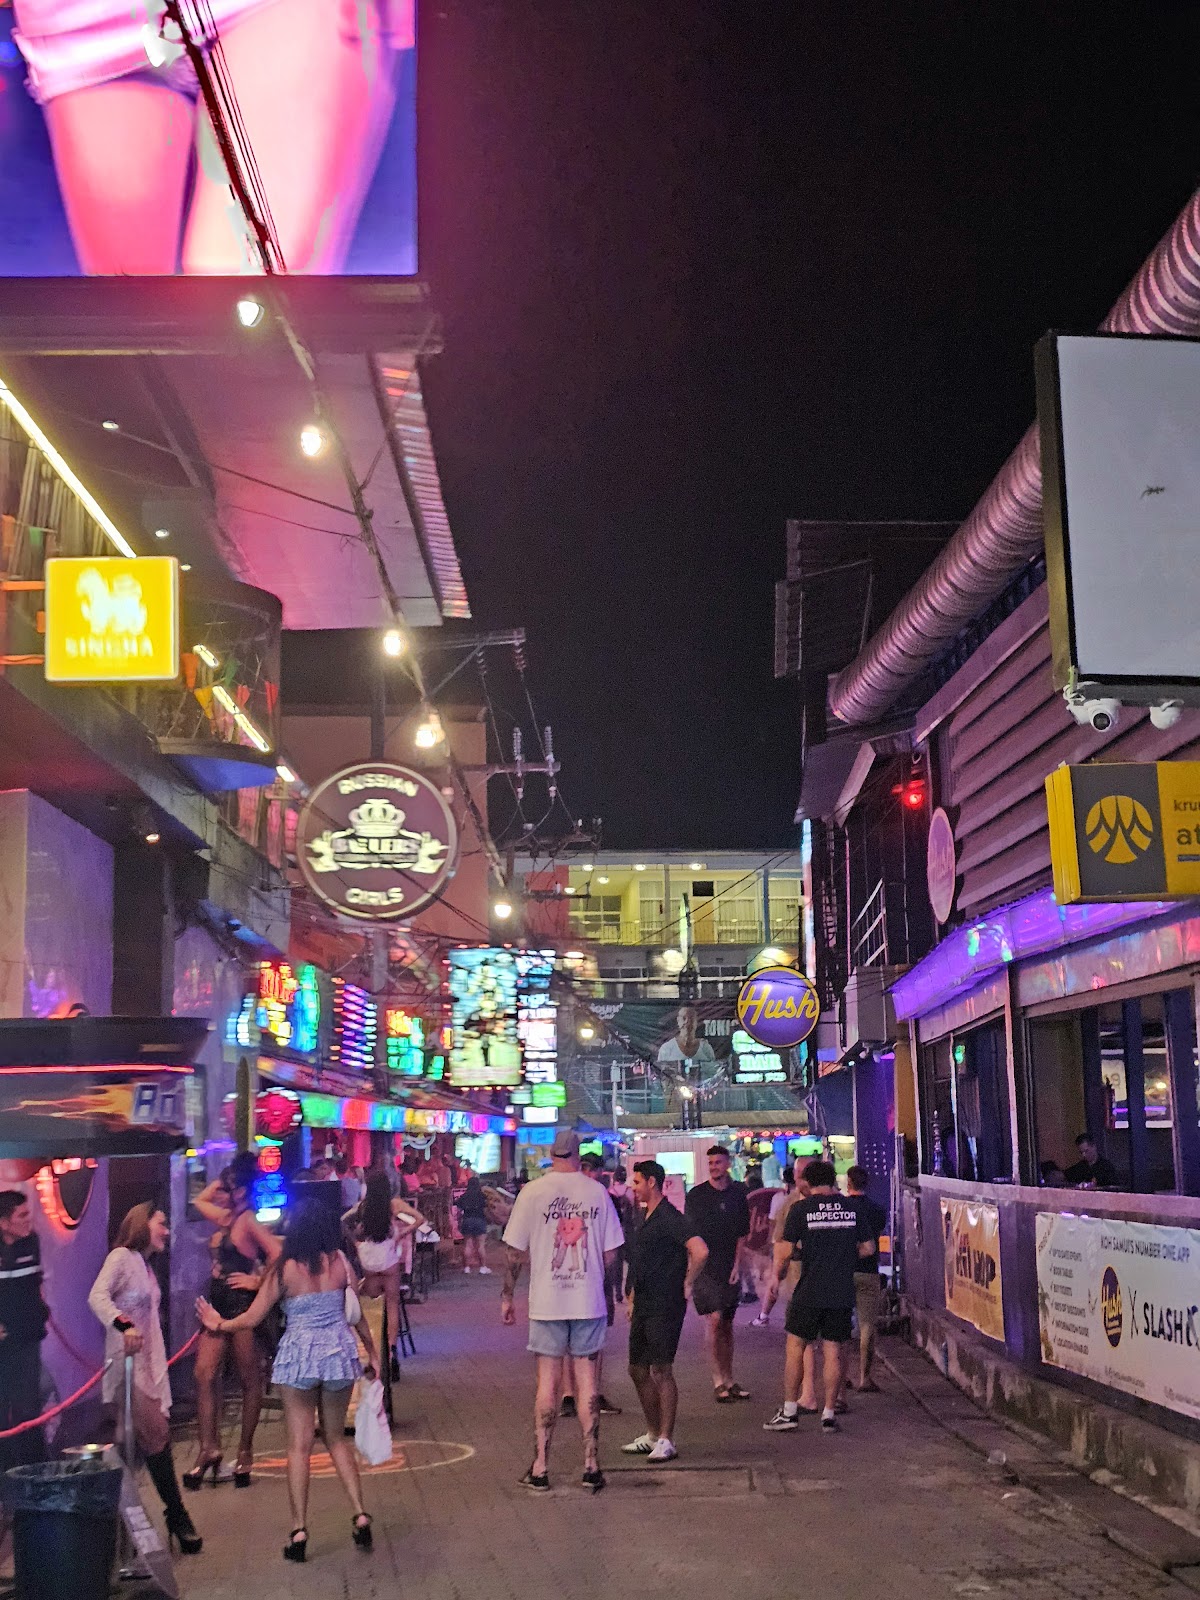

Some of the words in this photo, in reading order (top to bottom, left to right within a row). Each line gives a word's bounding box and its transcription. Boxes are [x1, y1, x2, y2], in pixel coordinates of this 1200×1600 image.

[740, 984, 817, 1026] Hush
[703, 1019, 740, 1037] TONI
[548, 1197, 582, 1212] Allow
[818, 1203, 844, 1211] P.E.D.
[543, 1207, 599, 1224] yourself
[806, 1211, 857, 1222] INSPECTOR
[1135, 1241, 1160, 1258] NUMBER
